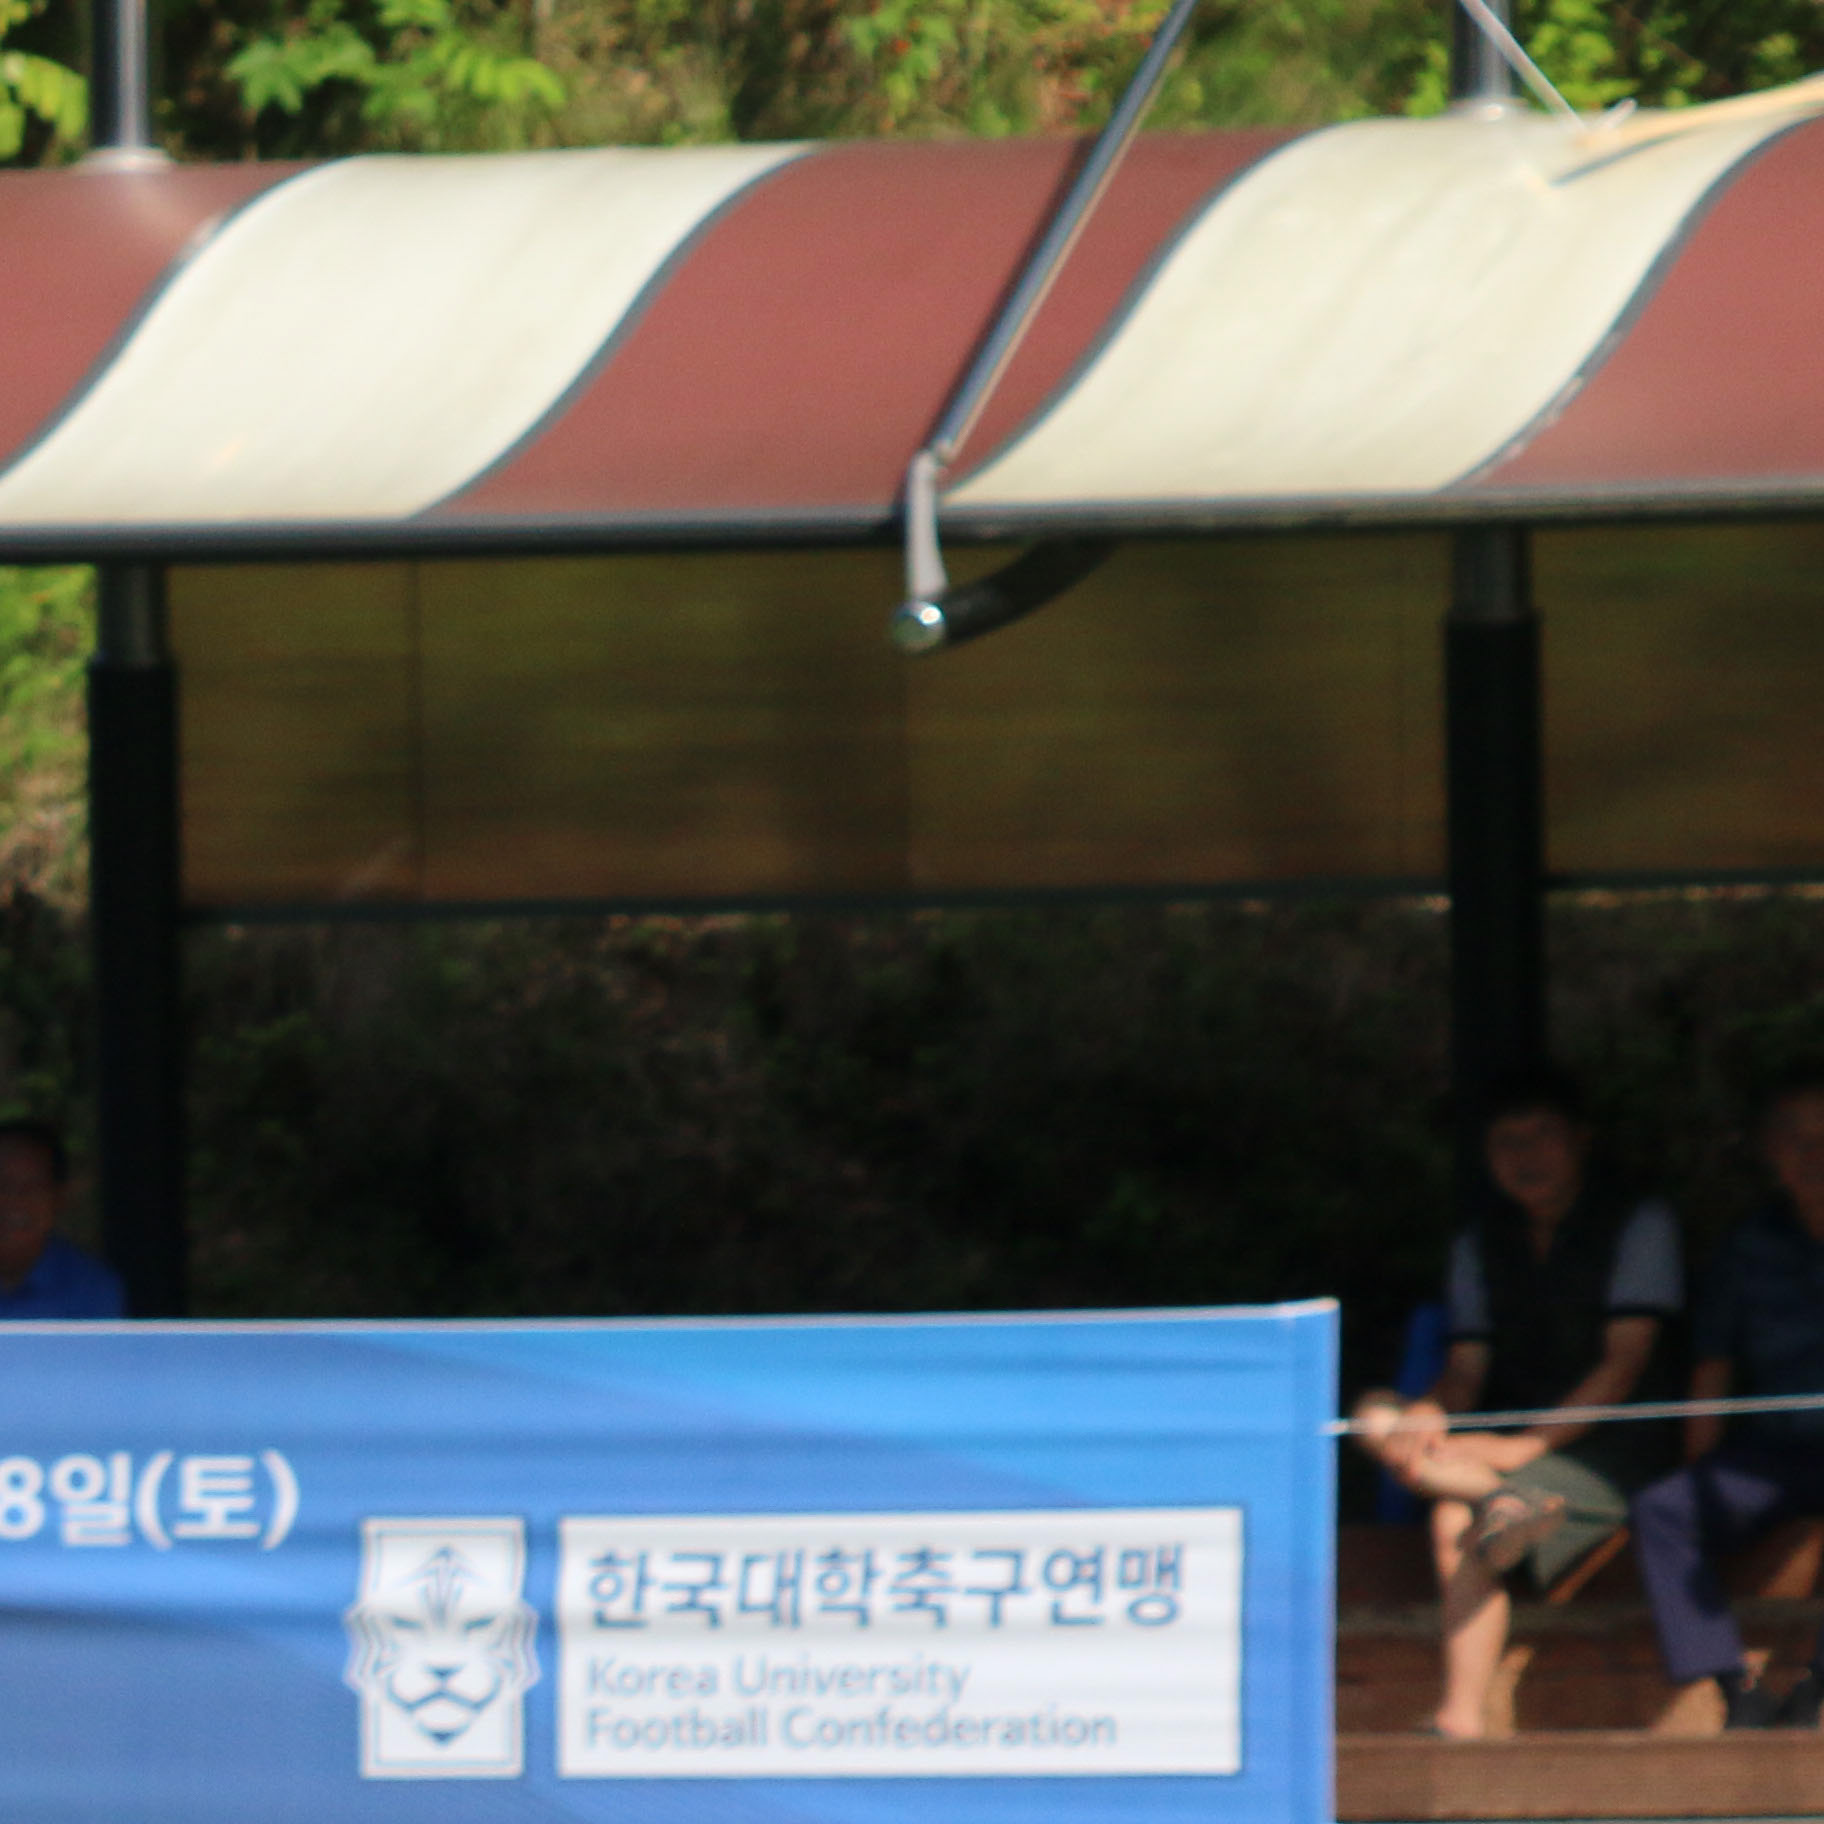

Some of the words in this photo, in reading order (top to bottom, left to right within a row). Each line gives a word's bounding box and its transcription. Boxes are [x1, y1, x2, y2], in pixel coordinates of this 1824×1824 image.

[586, 1541, 1184, 1631] 한국대학축구연맹
[585, 1656, 719, 1698] Korea
[732, 1653, 970, 1704] University
[585, 1706, 768, 1750] Football
[780, 1706, 1118, 1750] Confederation
